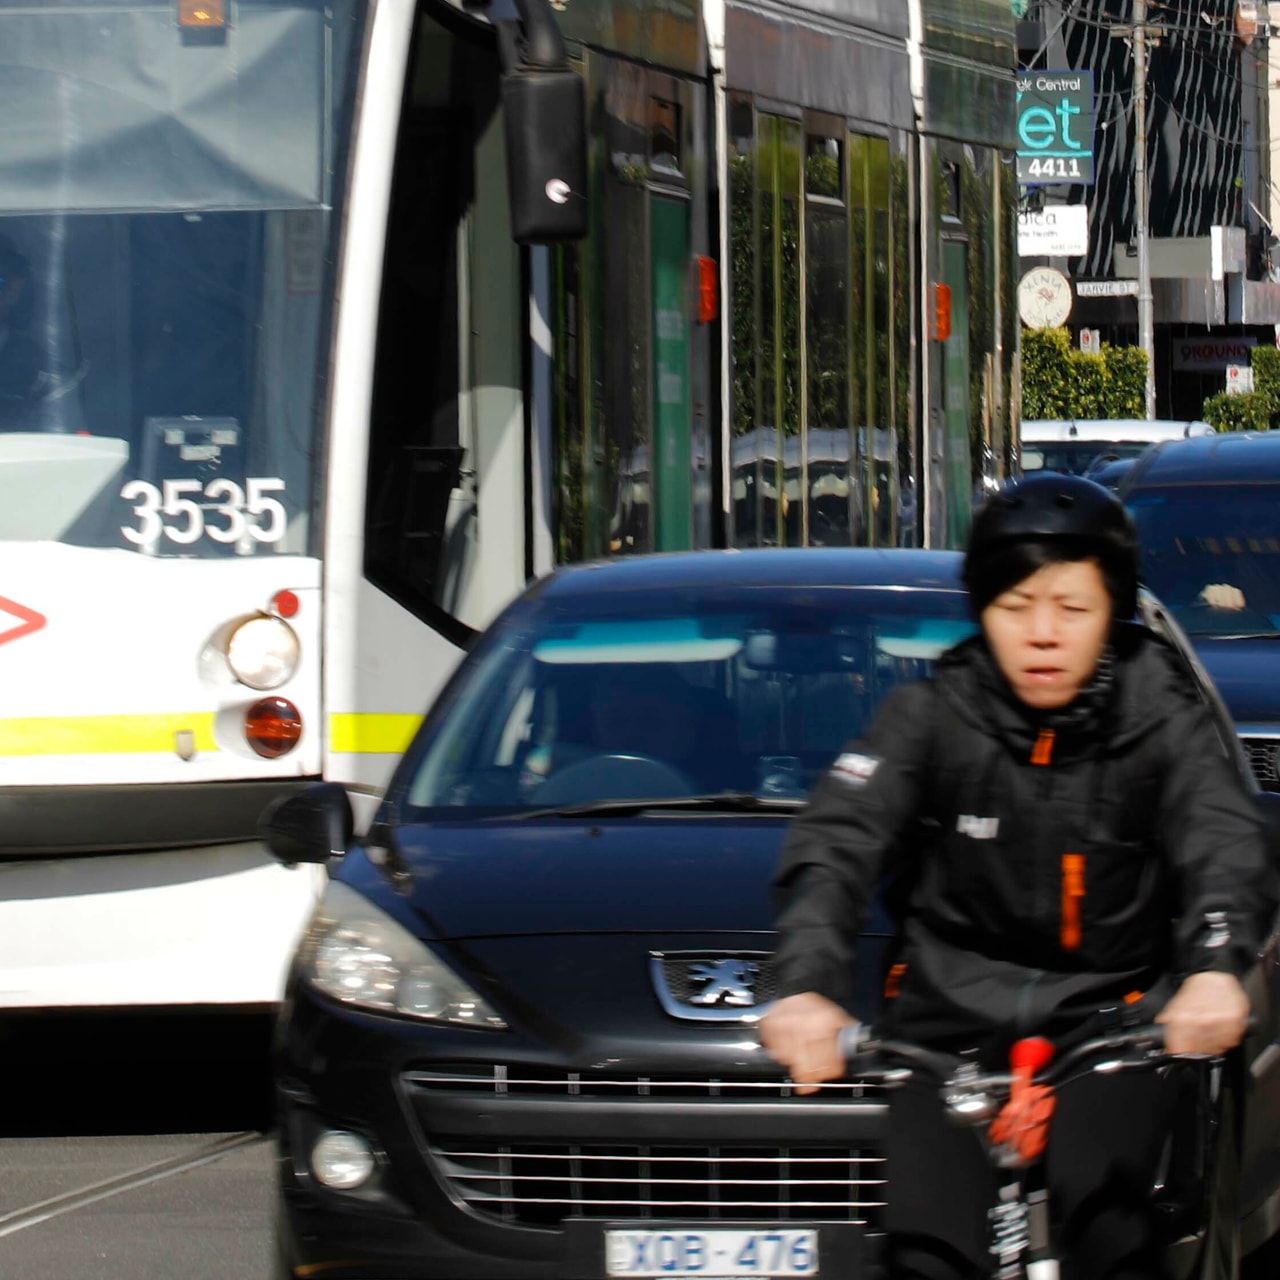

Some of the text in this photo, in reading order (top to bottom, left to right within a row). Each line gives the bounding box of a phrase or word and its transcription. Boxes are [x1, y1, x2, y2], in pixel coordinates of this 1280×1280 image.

[1036, 77, 1081, 91] Central
[1016, 92, 1081, 150] et
[1028, 158, 1081, 177] 4411
[120, 477, 287, 545] 3535
